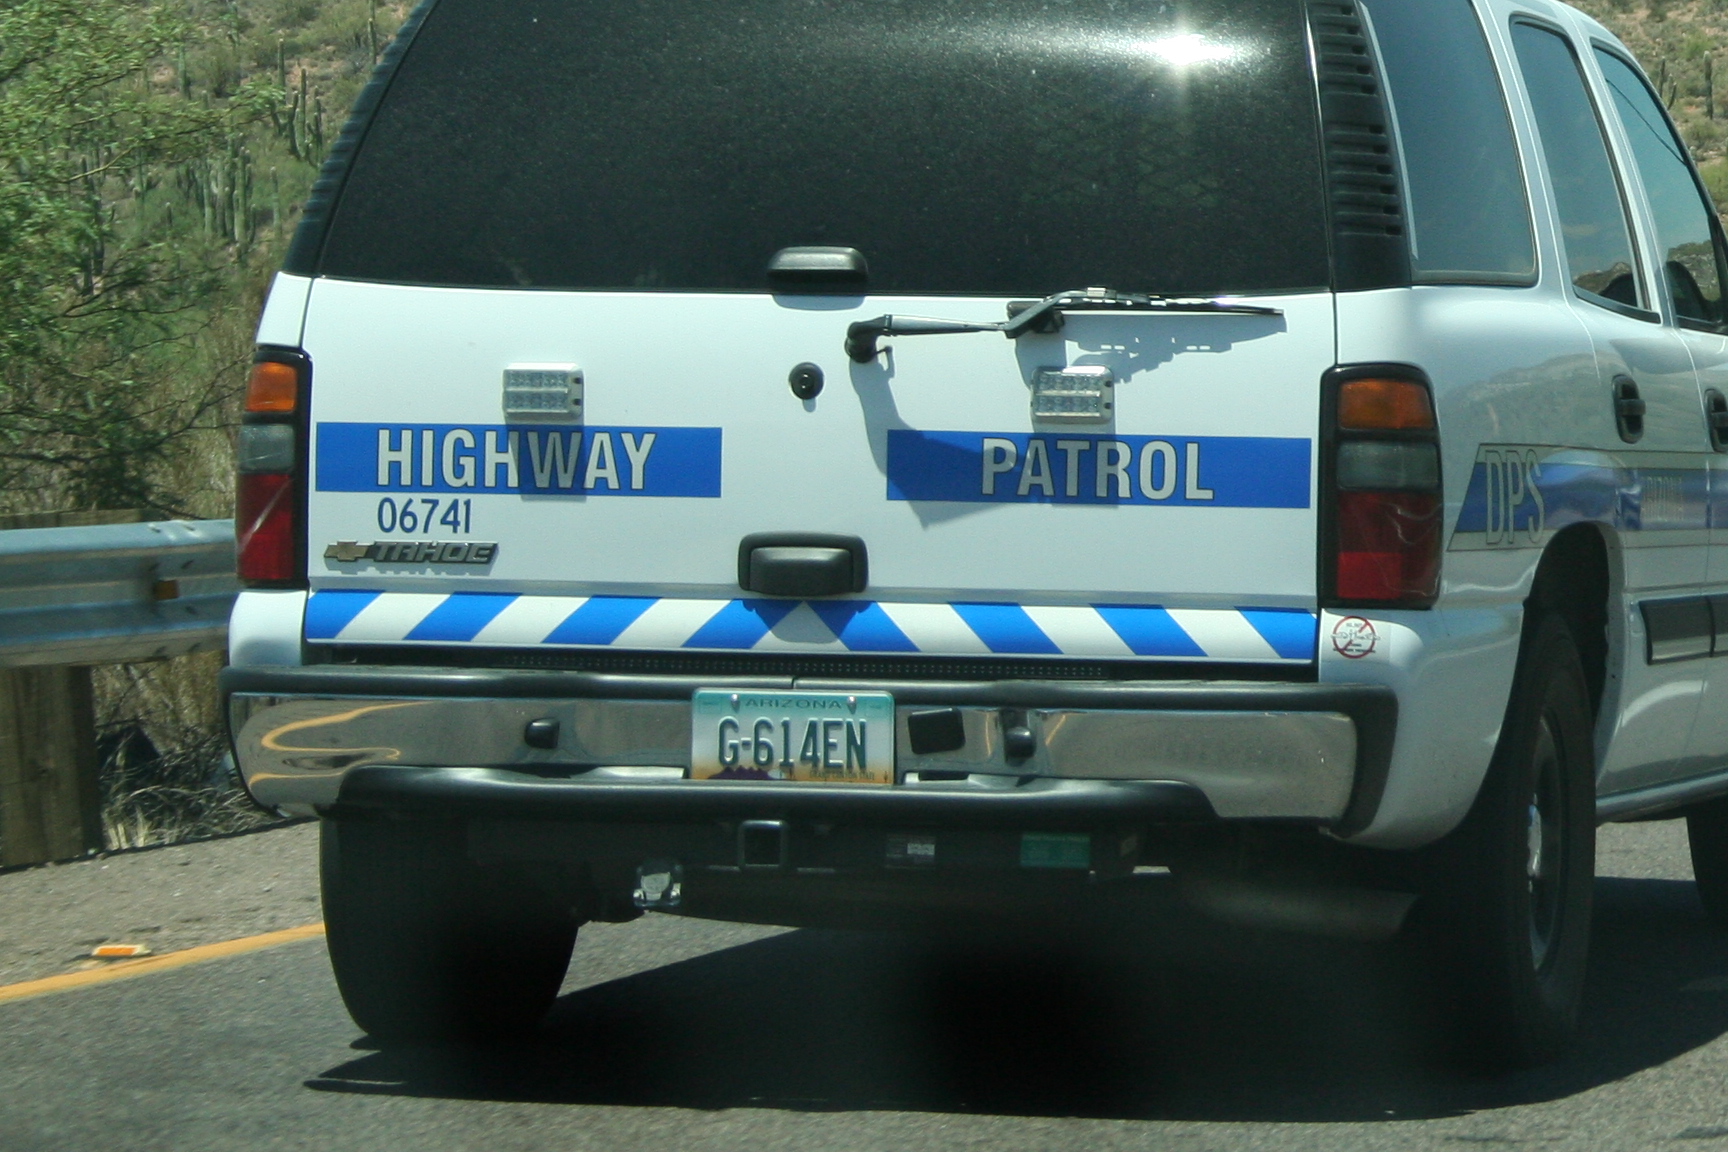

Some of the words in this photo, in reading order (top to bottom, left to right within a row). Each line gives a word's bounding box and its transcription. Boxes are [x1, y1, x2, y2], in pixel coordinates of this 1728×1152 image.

[377, 428, 657, 490] HIGHWAY
[981, 437, 1215, 501] PATROL
[377, 497, 472, 534] 06741
[1484, 448, 1546, 546] DPS
[374, 540, 496, 564] TAHOE
[745, 698, 843, 710] ARIZONA
[718, 716, 868, 769] G-614EN
